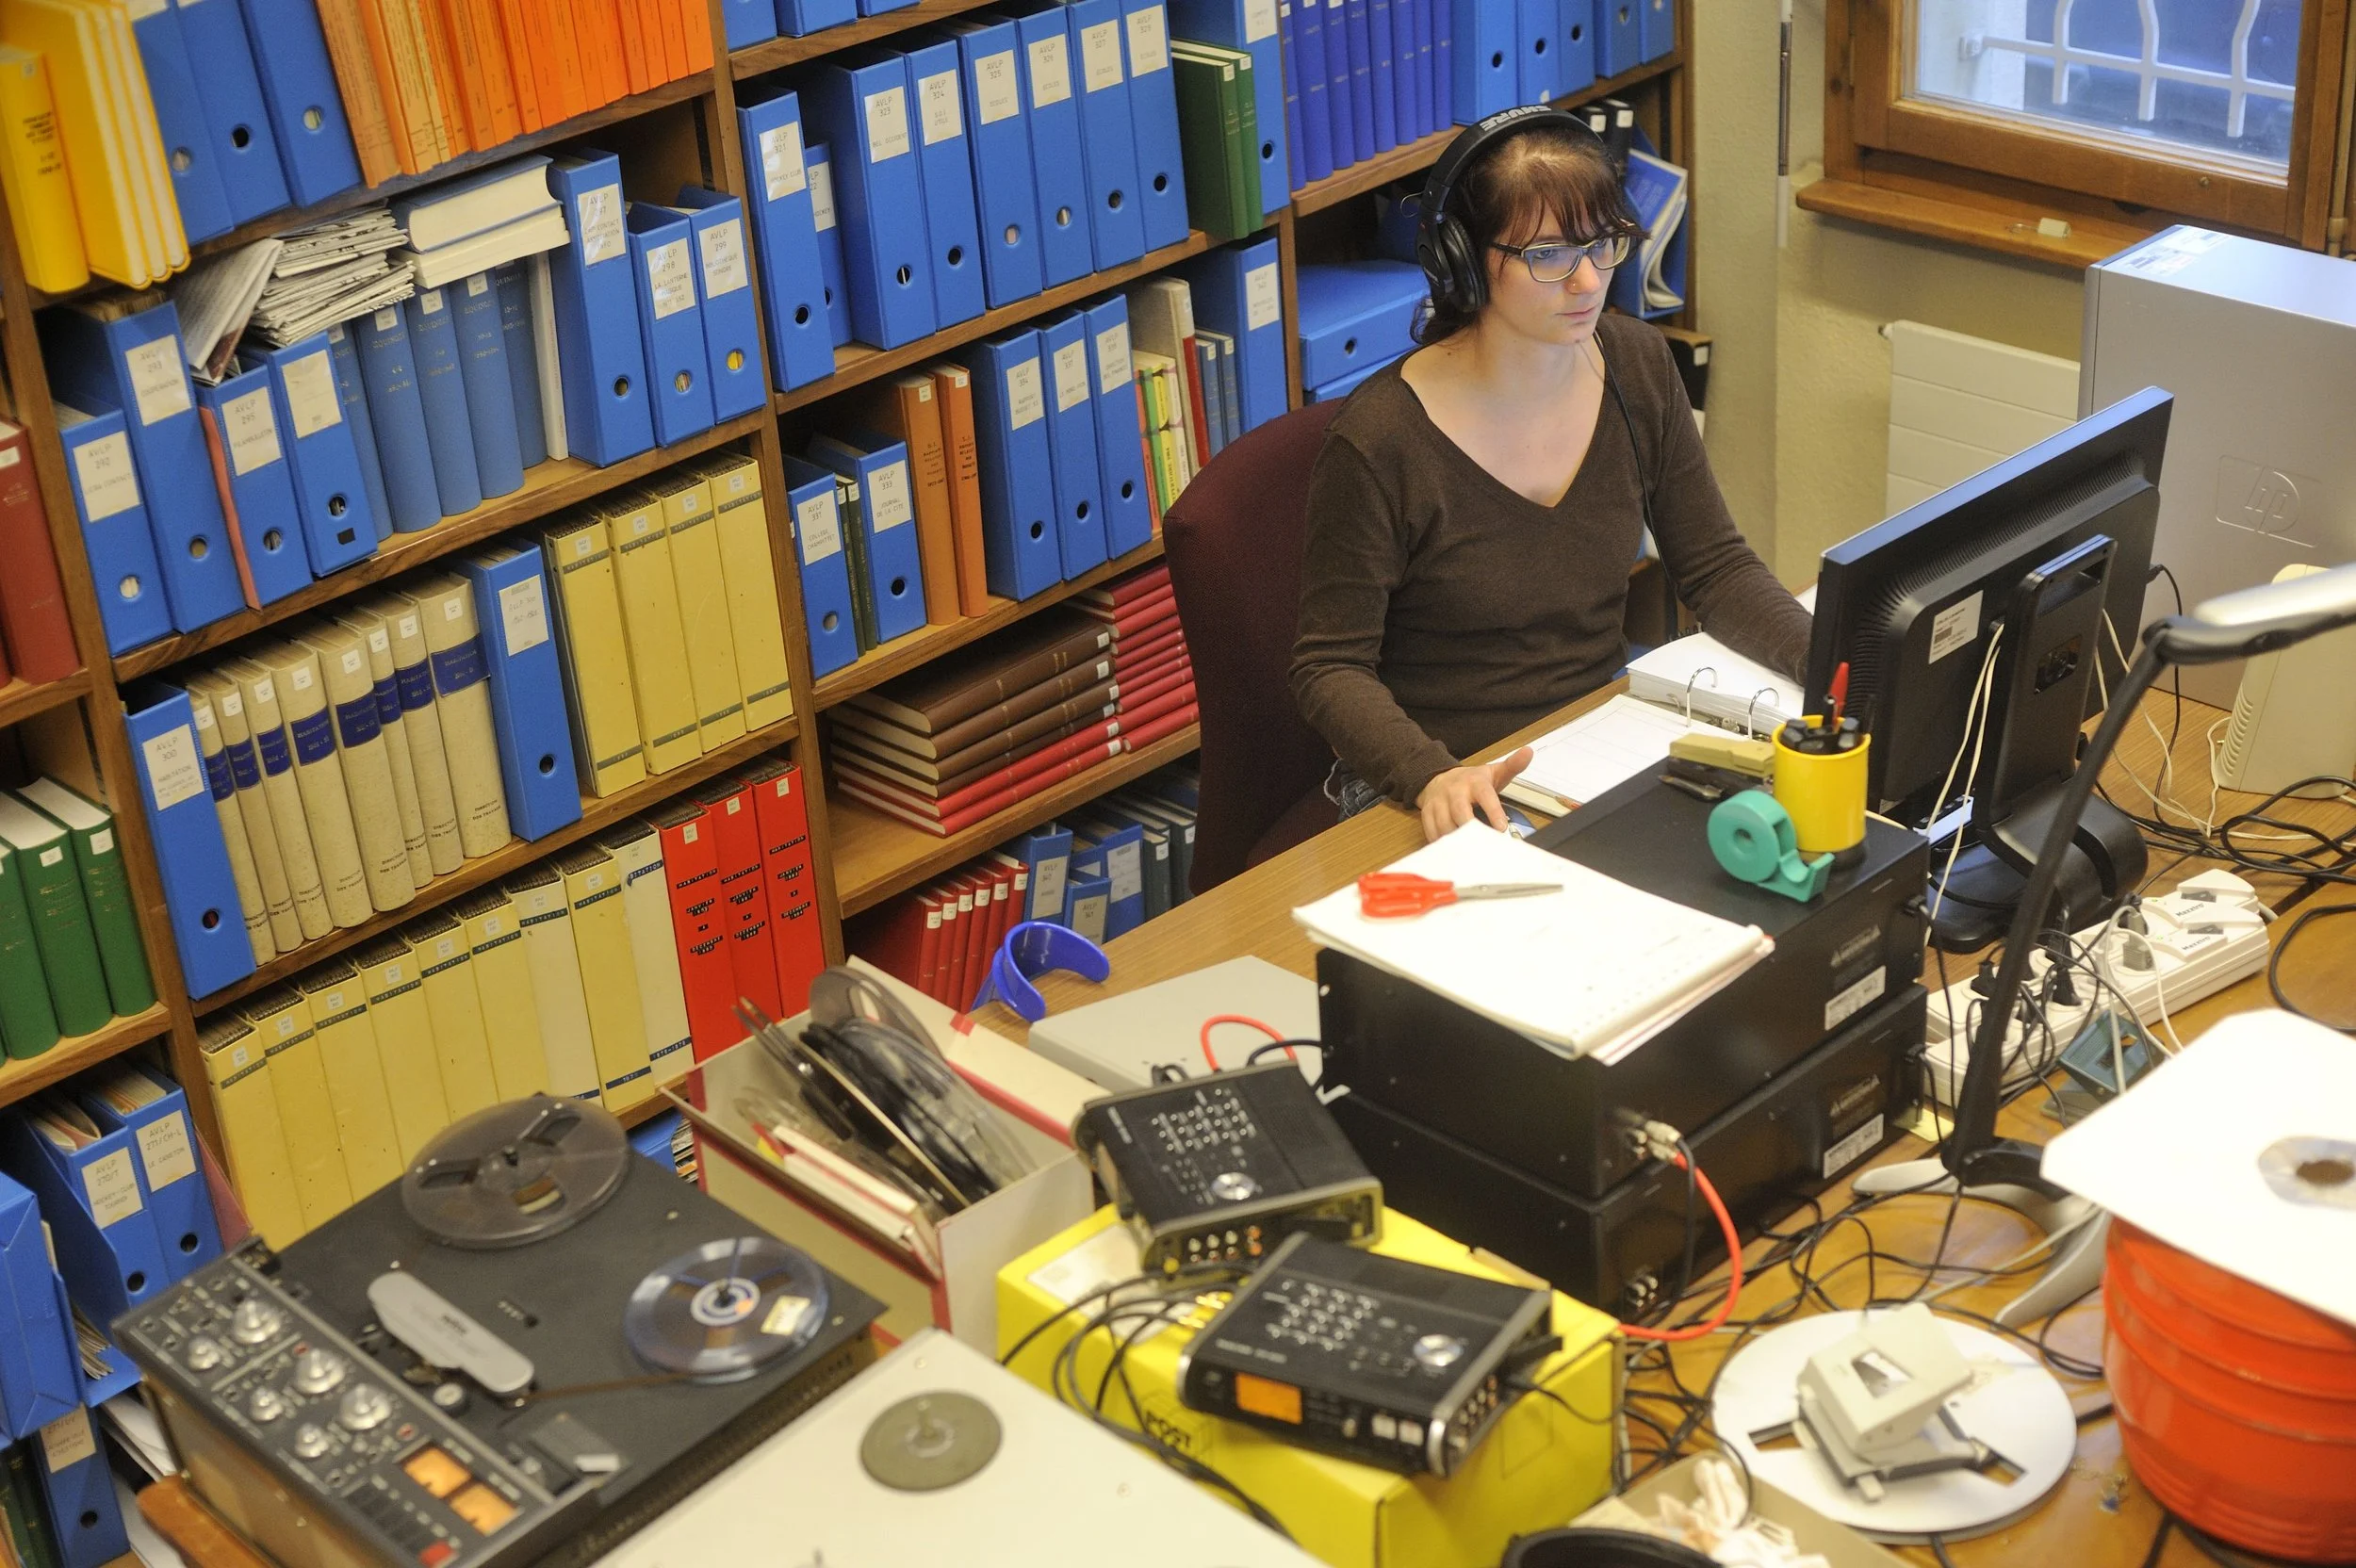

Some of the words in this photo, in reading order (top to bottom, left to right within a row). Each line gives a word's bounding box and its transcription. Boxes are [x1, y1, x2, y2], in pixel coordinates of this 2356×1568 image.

[1136, 13, 1152, 25] AVLP
[1091, 28, 1106, 40] AVLP
[1039, 41, 1055, 54] AVLP
[986, 58, 1003, 71] AVLP
[989, 68, 1001, 79] 325
[928, 78, 946, 90] AVLP
[875, 95, 892, 107] AVLP
[878, 106, 891, 117] 323
[1479, 106, 1552, 132] SHURE
[770, 131, 788, 144] AVLP
[773, 141, 786, 155] 321
[589, 191, 609, 205] AVLP
[709, 227, 728, 241] AVLP
[714, 239, 728, 252] 299
[656, 247, 677, 262] AVLP
[661, 260, 676, 272] 298
[233, 398, 256, 415] AVLP
[877, 469, 895, 482] AVLP
[881, 479, 892, 491] 333
[807, 499, 824, 514] AVLP
[810, 510, 822, 522] 331
[155, 735, 178, 752] AVLP
[160, 747, 177, 762] 300
[771, 836, 805, 854] HABITATION
[723, 865, 759, 882] HABITATION
[779, 864, 802, 877] JANVIER
[679, 869, 716, 888] HABITATION
[732, 888, 756, 902] JANVIER
[687, 898, 713, 913] JANVIER
[521, 909, 565, 926] HABITATION
[735, 922, 762, 938] DECEMBRE
[478, 931, 519, 952] HABITATION
[691, 936, 721, 952] DECEMBRE
[427, 955, 467, 974] HABITATION
[148, 1120, 172, 1138] AVLP
[93, 1157, 118, 1176] AVLP
[1146, 1411, 1190, 1448] POST
